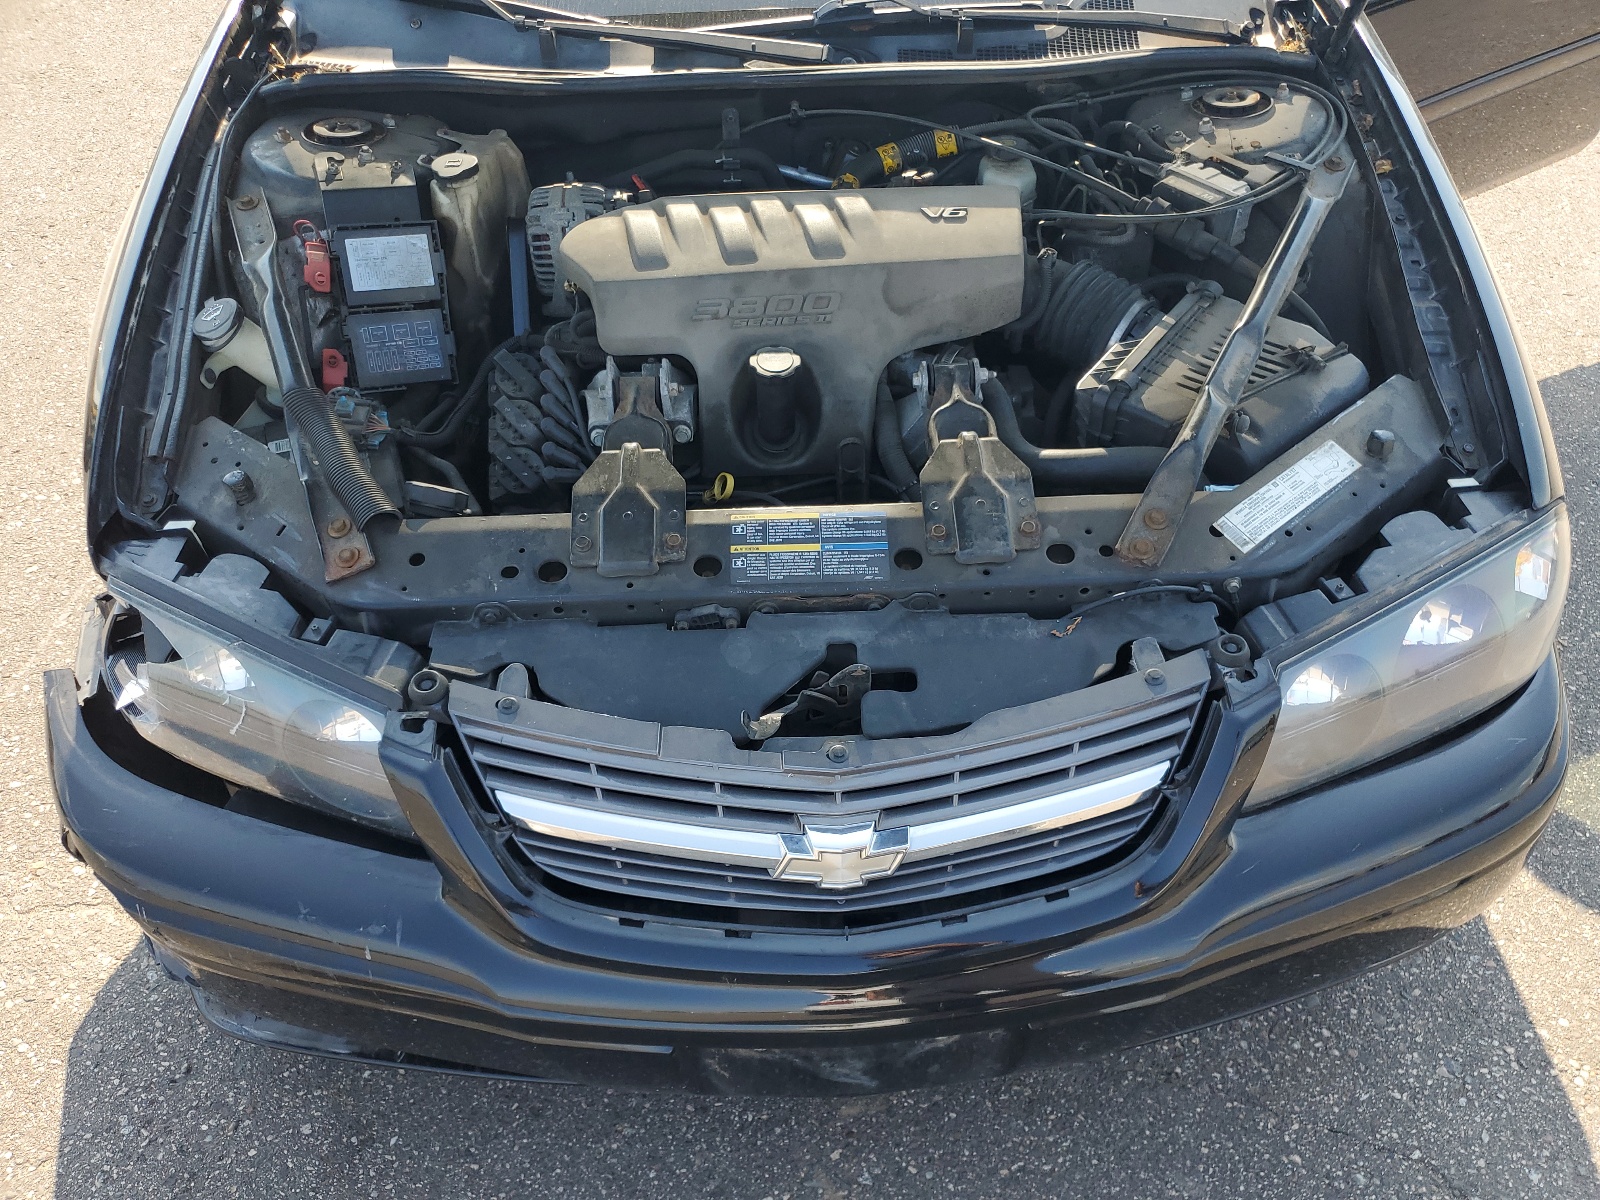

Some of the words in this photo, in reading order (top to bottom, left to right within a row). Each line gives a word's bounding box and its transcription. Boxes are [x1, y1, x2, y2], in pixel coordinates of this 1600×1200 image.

[920, 206, 968, 218] V6
[691, 292, 842, 322] 3800
[731, 315, 813, 328] SERIES
